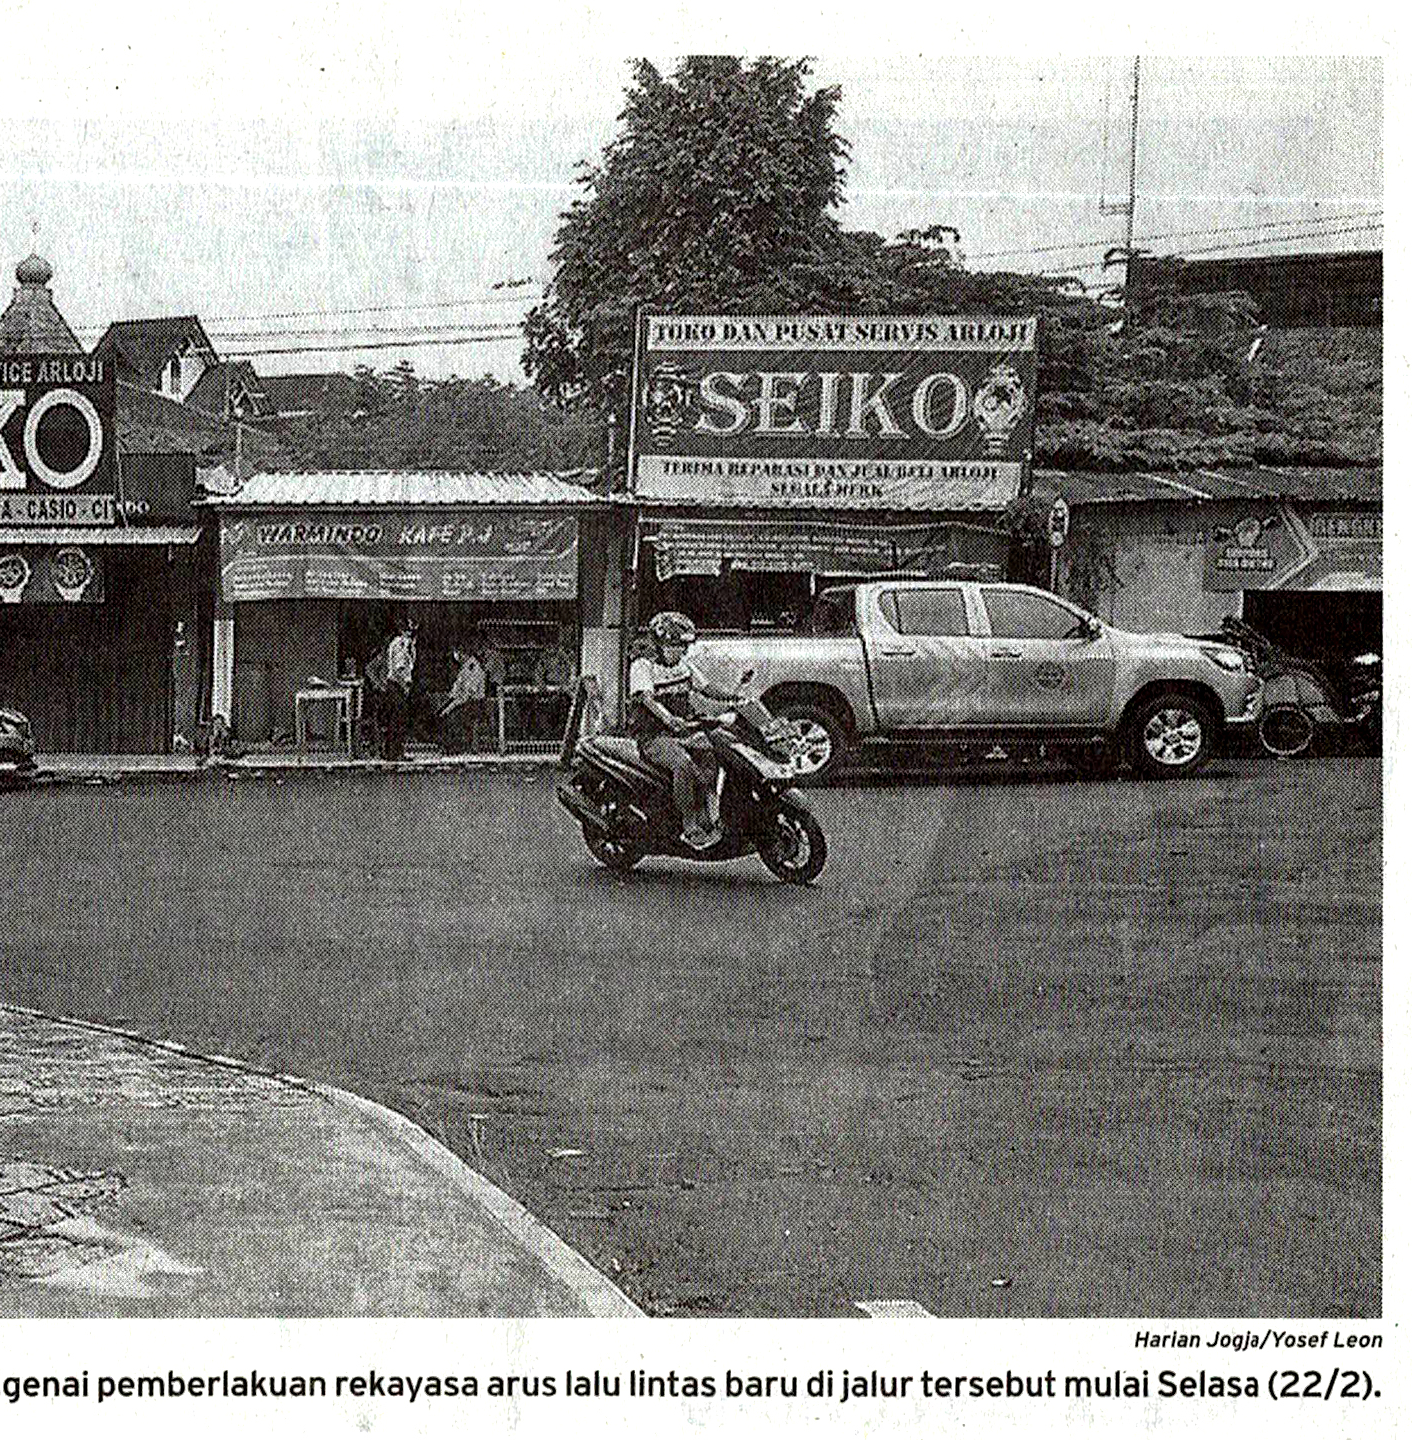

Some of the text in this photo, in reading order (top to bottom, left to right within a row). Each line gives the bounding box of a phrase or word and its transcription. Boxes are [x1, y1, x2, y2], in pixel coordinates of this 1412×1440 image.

[655, 323, 1028, 343] TOKO DAN PUSAT SERVIS ARLOJI
[37, 360, 104, 383] ARLOJI
[694, 370, 969, 440] SEIKO
[662, 461, 723, 476] TERIMA
[728, 462, 810, 478] REPARASI
[814, 463, 847, 479] DAN
[28, 499, 77, 520] CASIO
[257, 524, 383, 545] WARMINDO
